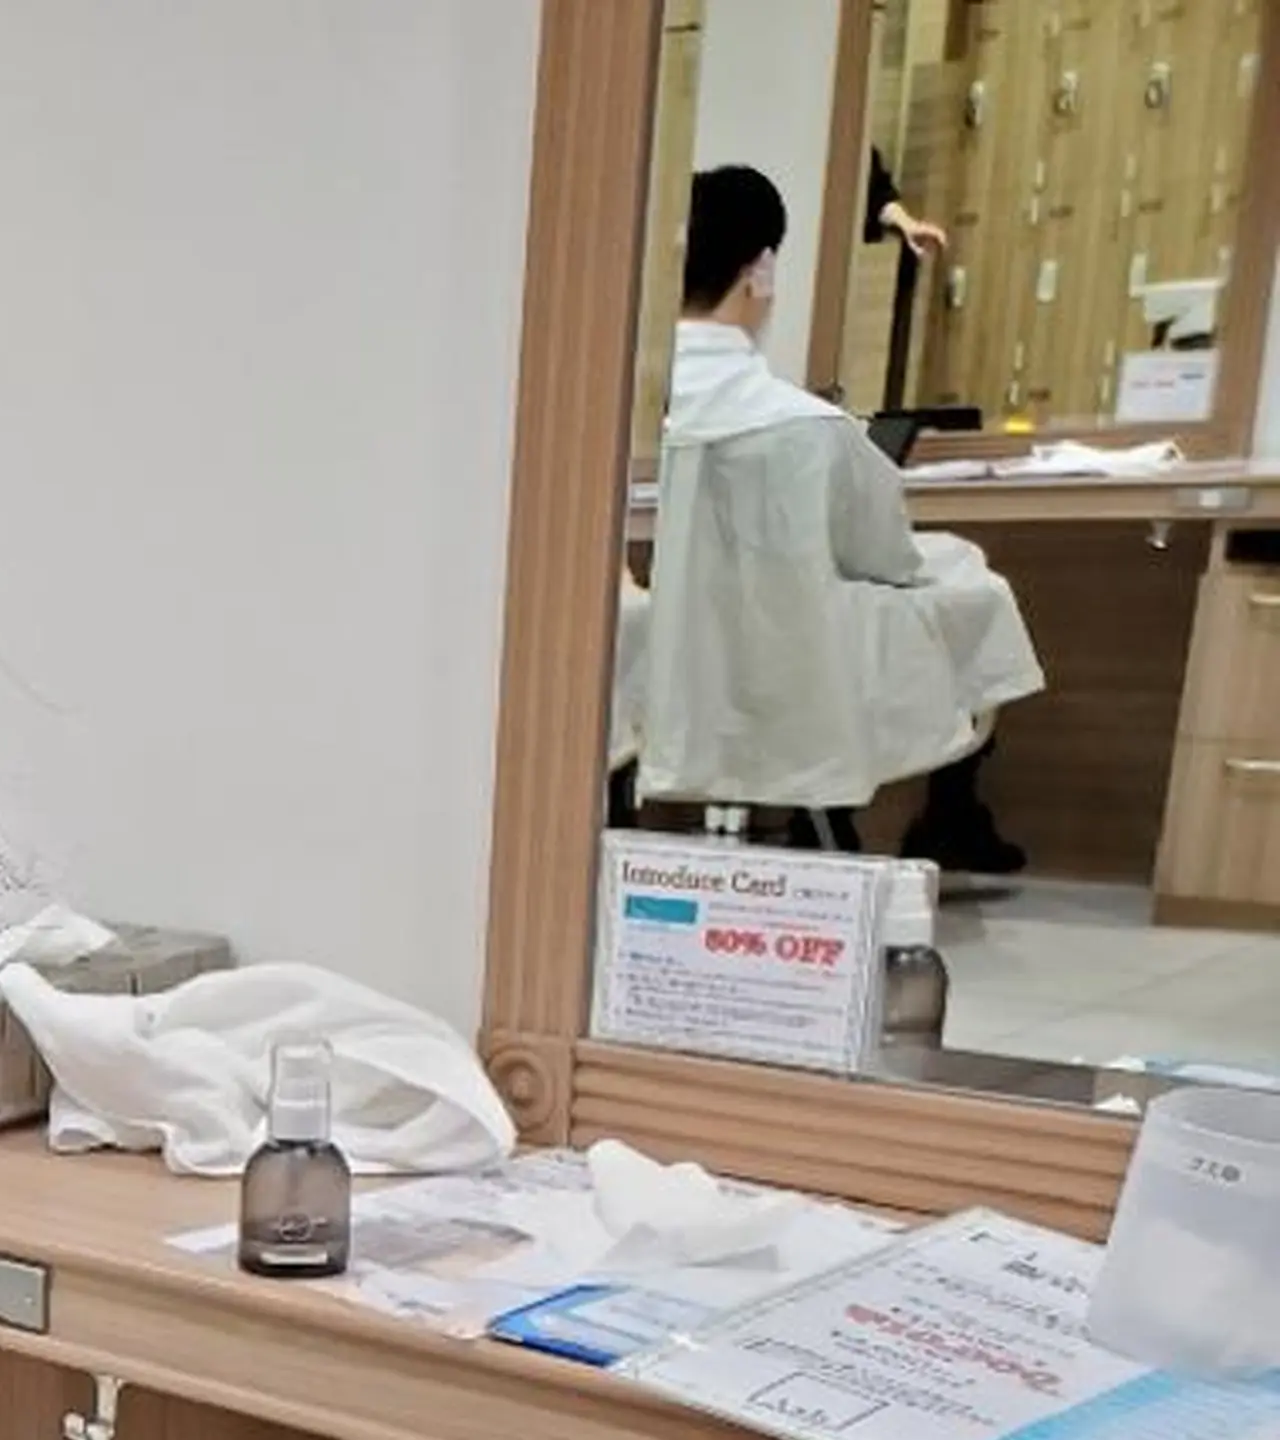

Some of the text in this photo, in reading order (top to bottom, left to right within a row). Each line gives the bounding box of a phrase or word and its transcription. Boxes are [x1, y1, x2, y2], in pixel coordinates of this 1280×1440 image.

[621, 861, 725, 893] Introduce
[730, 871, 786, 898] Card
[775, 935, 845, 966] OFF
